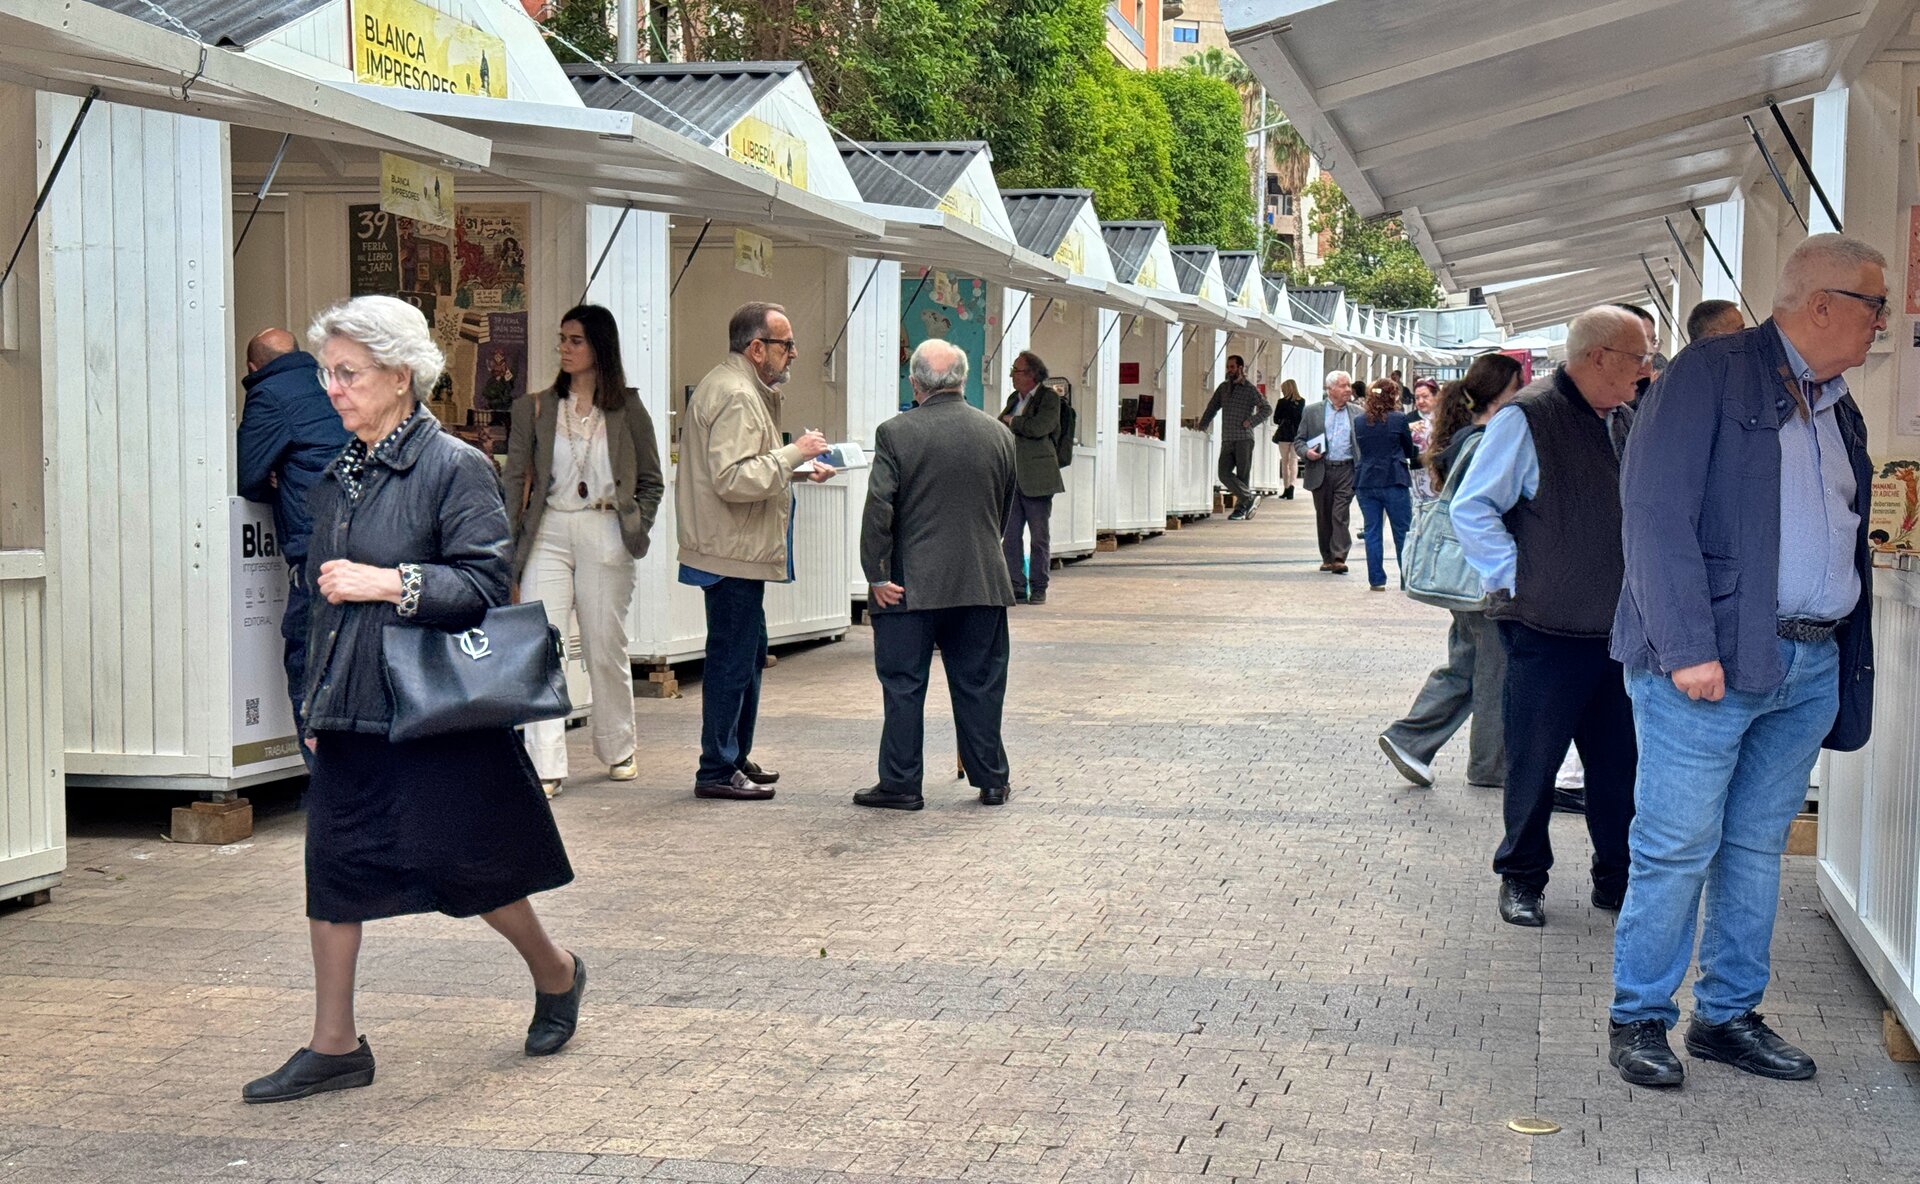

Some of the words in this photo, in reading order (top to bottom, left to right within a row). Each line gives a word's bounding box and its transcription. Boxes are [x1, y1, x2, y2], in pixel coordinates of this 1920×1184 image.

[365, 14, 426, 63] BLANCA
[366, 48, 457, 94] IMPRESORES
[743, 138, 775, 168] LIBRERÍA
[391, 174, 410, 187] BLANCA
[391, 186, 420, 201] IMPRESORES
[357, 211, 389, 240] 39
[362, 242, 388, 251] FERIA
[367, 253, 393, 262] LIBRO
[367, 262, 392, 274] JAÉN
[243, 561, 282, 576] impresores
[244, 616, 273, 628] EDITORIAL
